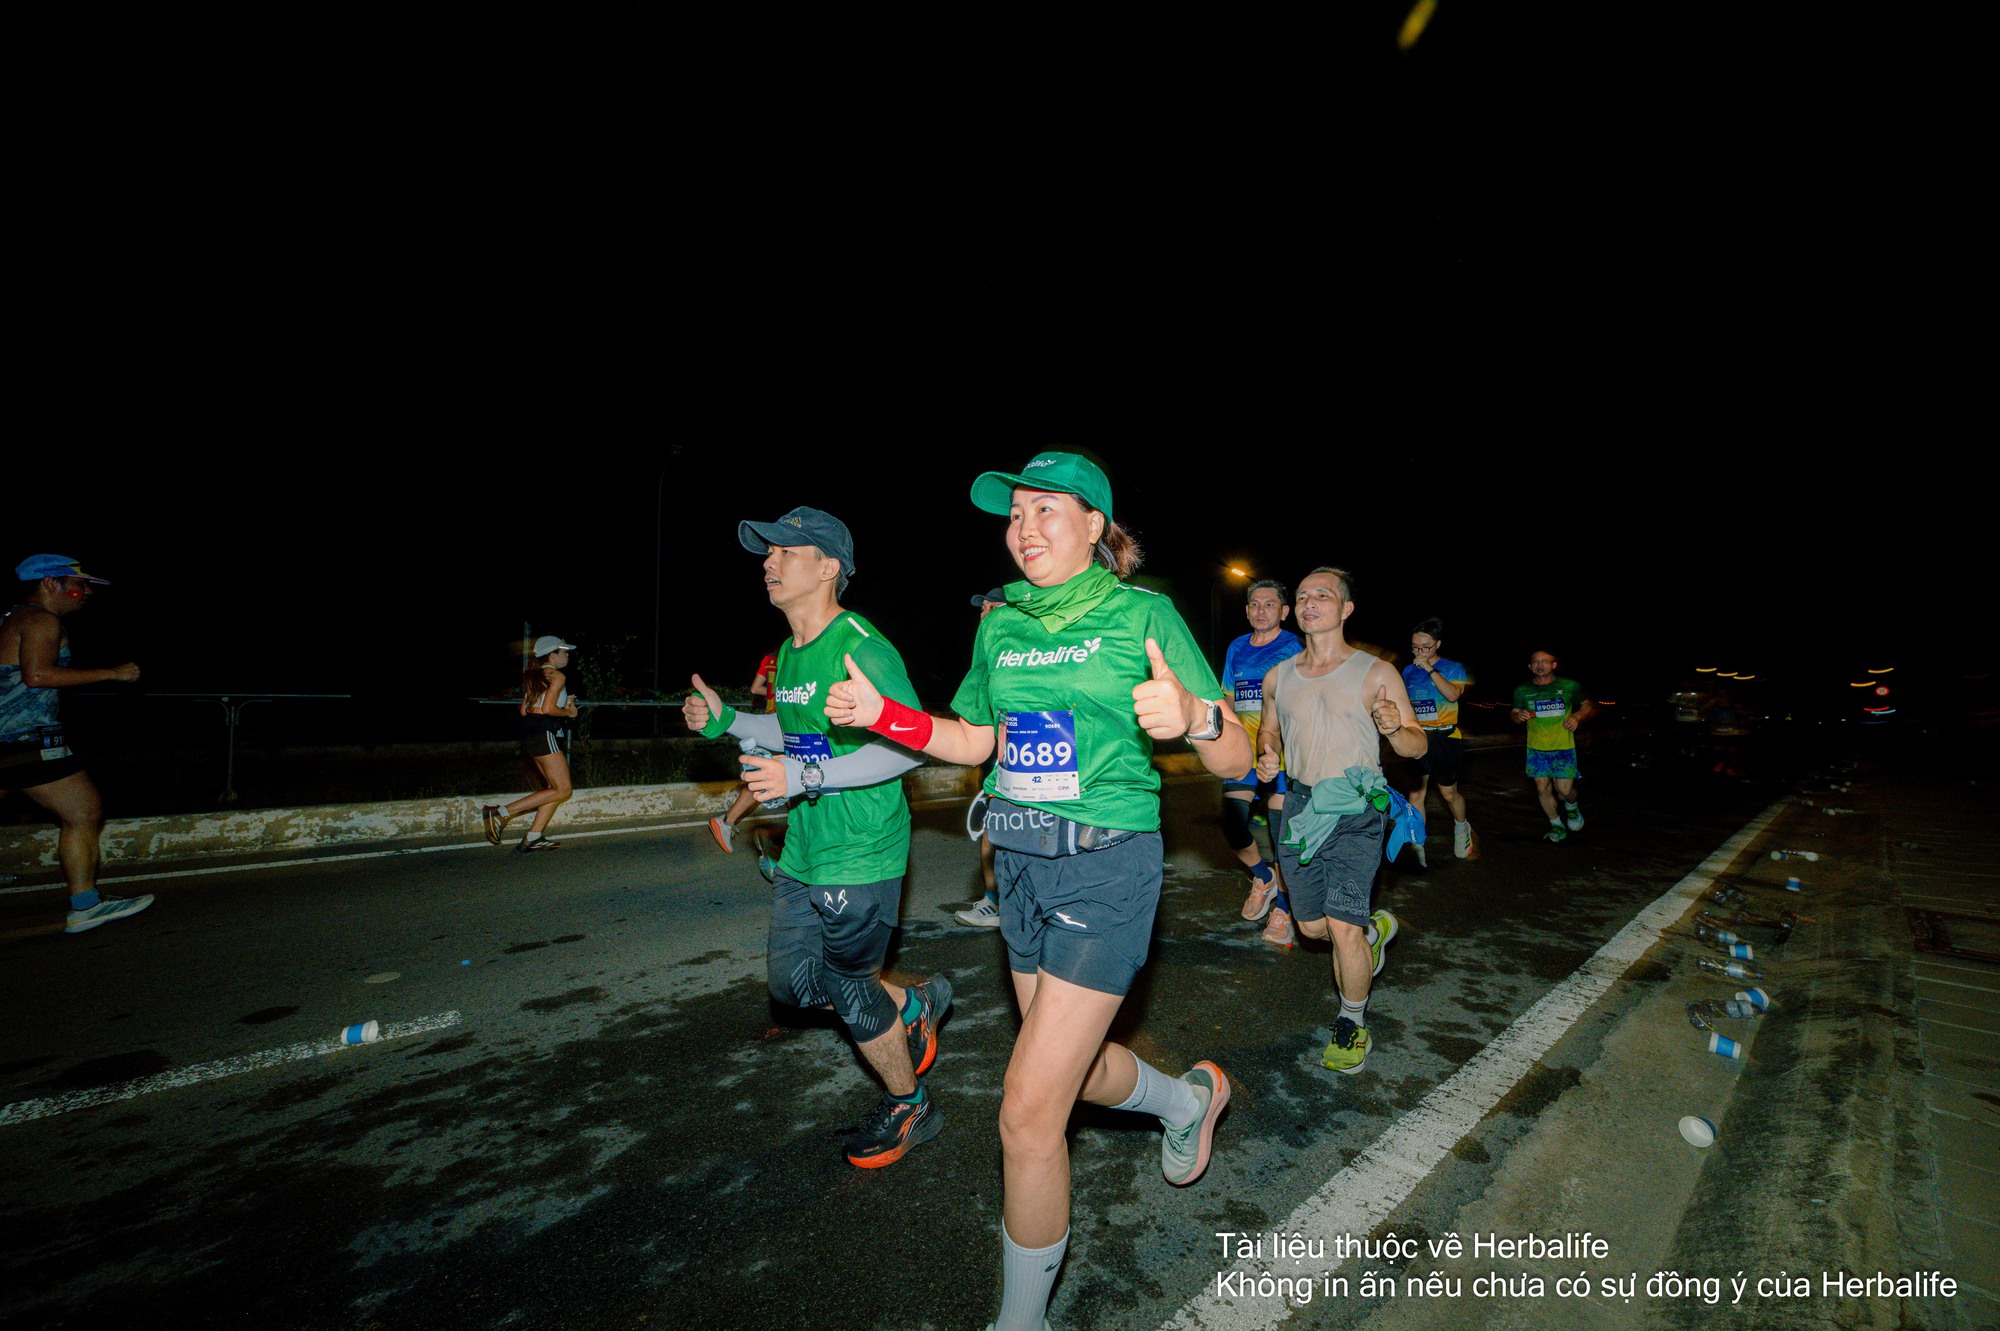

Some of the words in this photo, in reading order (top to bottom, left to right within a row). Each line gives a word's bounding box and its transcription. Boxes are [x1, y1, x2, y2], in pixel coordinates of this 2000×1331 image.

[996, 646, 1088, 668] Herbalife
[1240, 689, 1263, 699] 91013
[1541, 703, 1565, 711] 90030
[1003, 741, 1072, 767] 0689
[1031, 775, 1042, 784] 42
